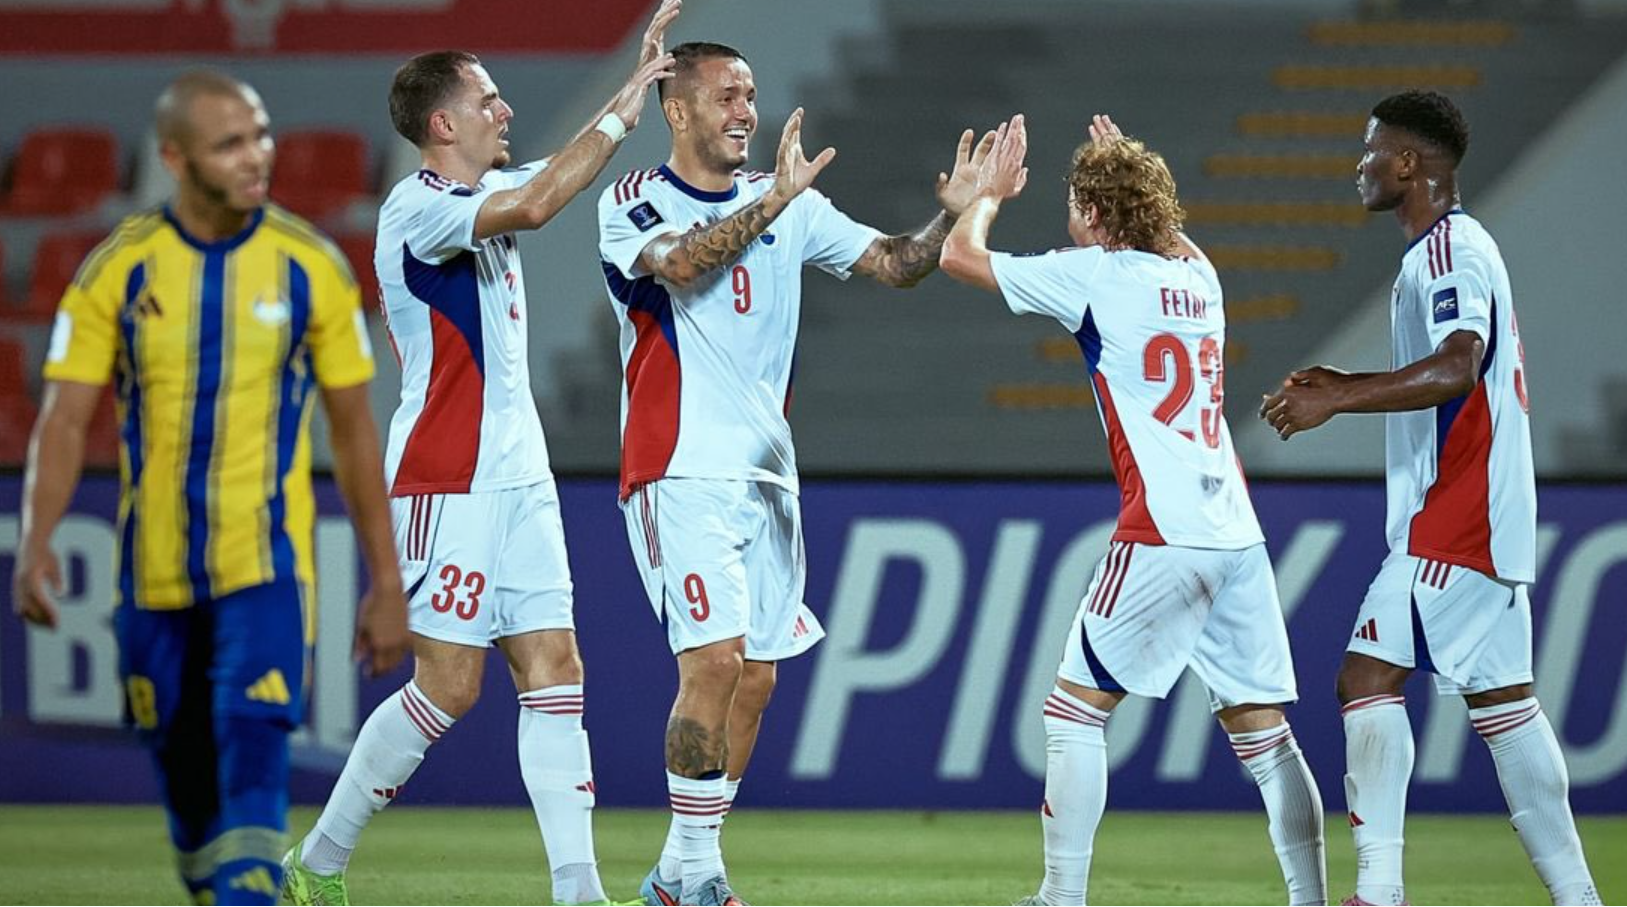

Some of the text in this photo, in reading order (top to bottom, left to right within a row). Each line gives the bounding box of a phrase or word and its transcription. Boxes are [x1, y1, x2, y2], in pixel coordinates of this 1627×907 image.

[732, 264, 751, 314] 9
[1142, 332, 1224, 449] 23
[431, 564, 486, 620] 33
[683, 573, 711, 622] 9
